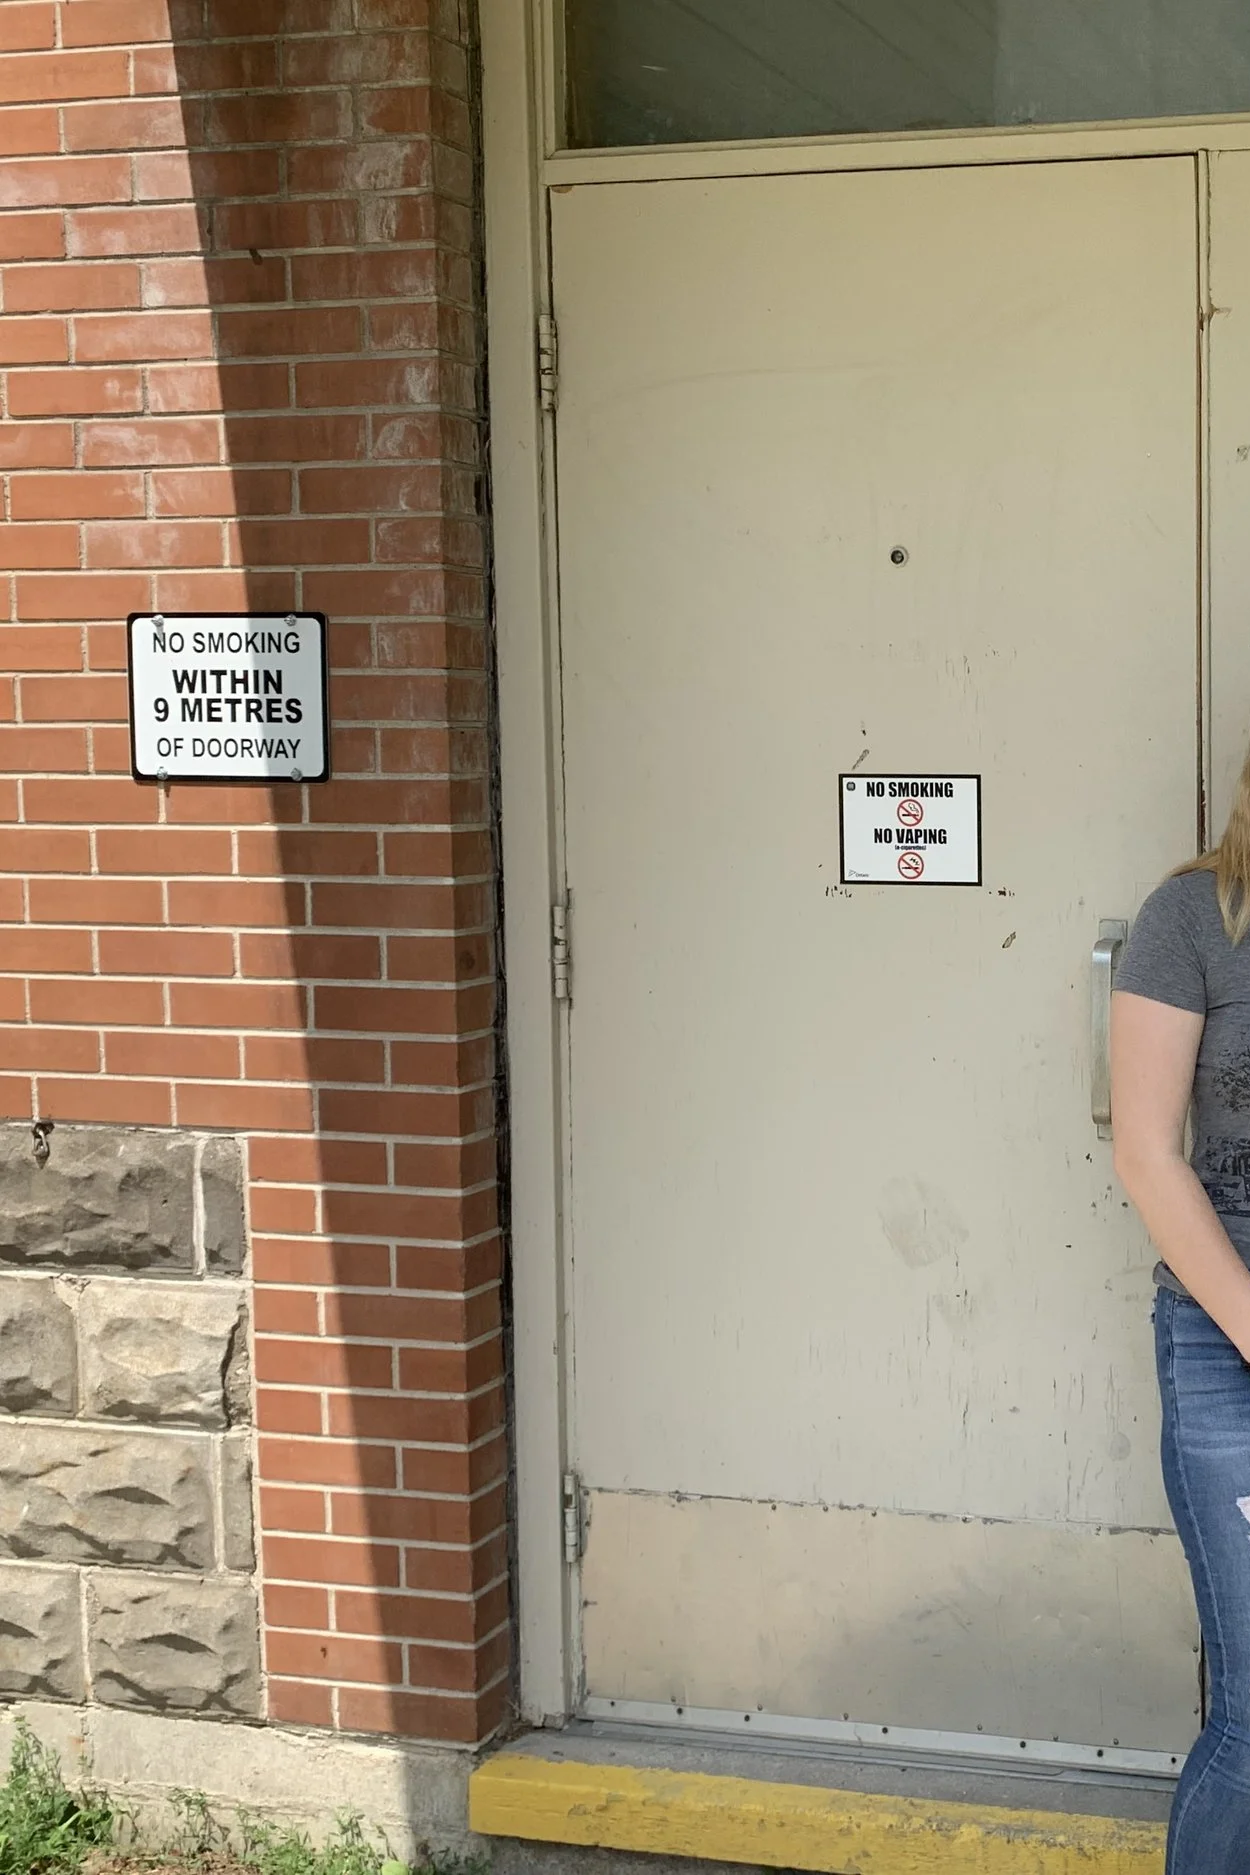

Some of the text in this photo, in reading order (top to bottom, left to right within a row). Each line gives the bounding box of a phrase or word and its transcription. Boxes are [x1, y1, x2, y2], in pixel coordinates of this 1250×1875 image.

[153, 632, 301, 654] NO SMOKING
[172, 669, 283, 695] WITHIN
[153, 697, 304, 724] 9 METRES
[157, 737, 301, 759] OF DOORWAY
[866, 781, 954, 798] NO SMOKING
[874, 828, 947, 845] NO VAPING
